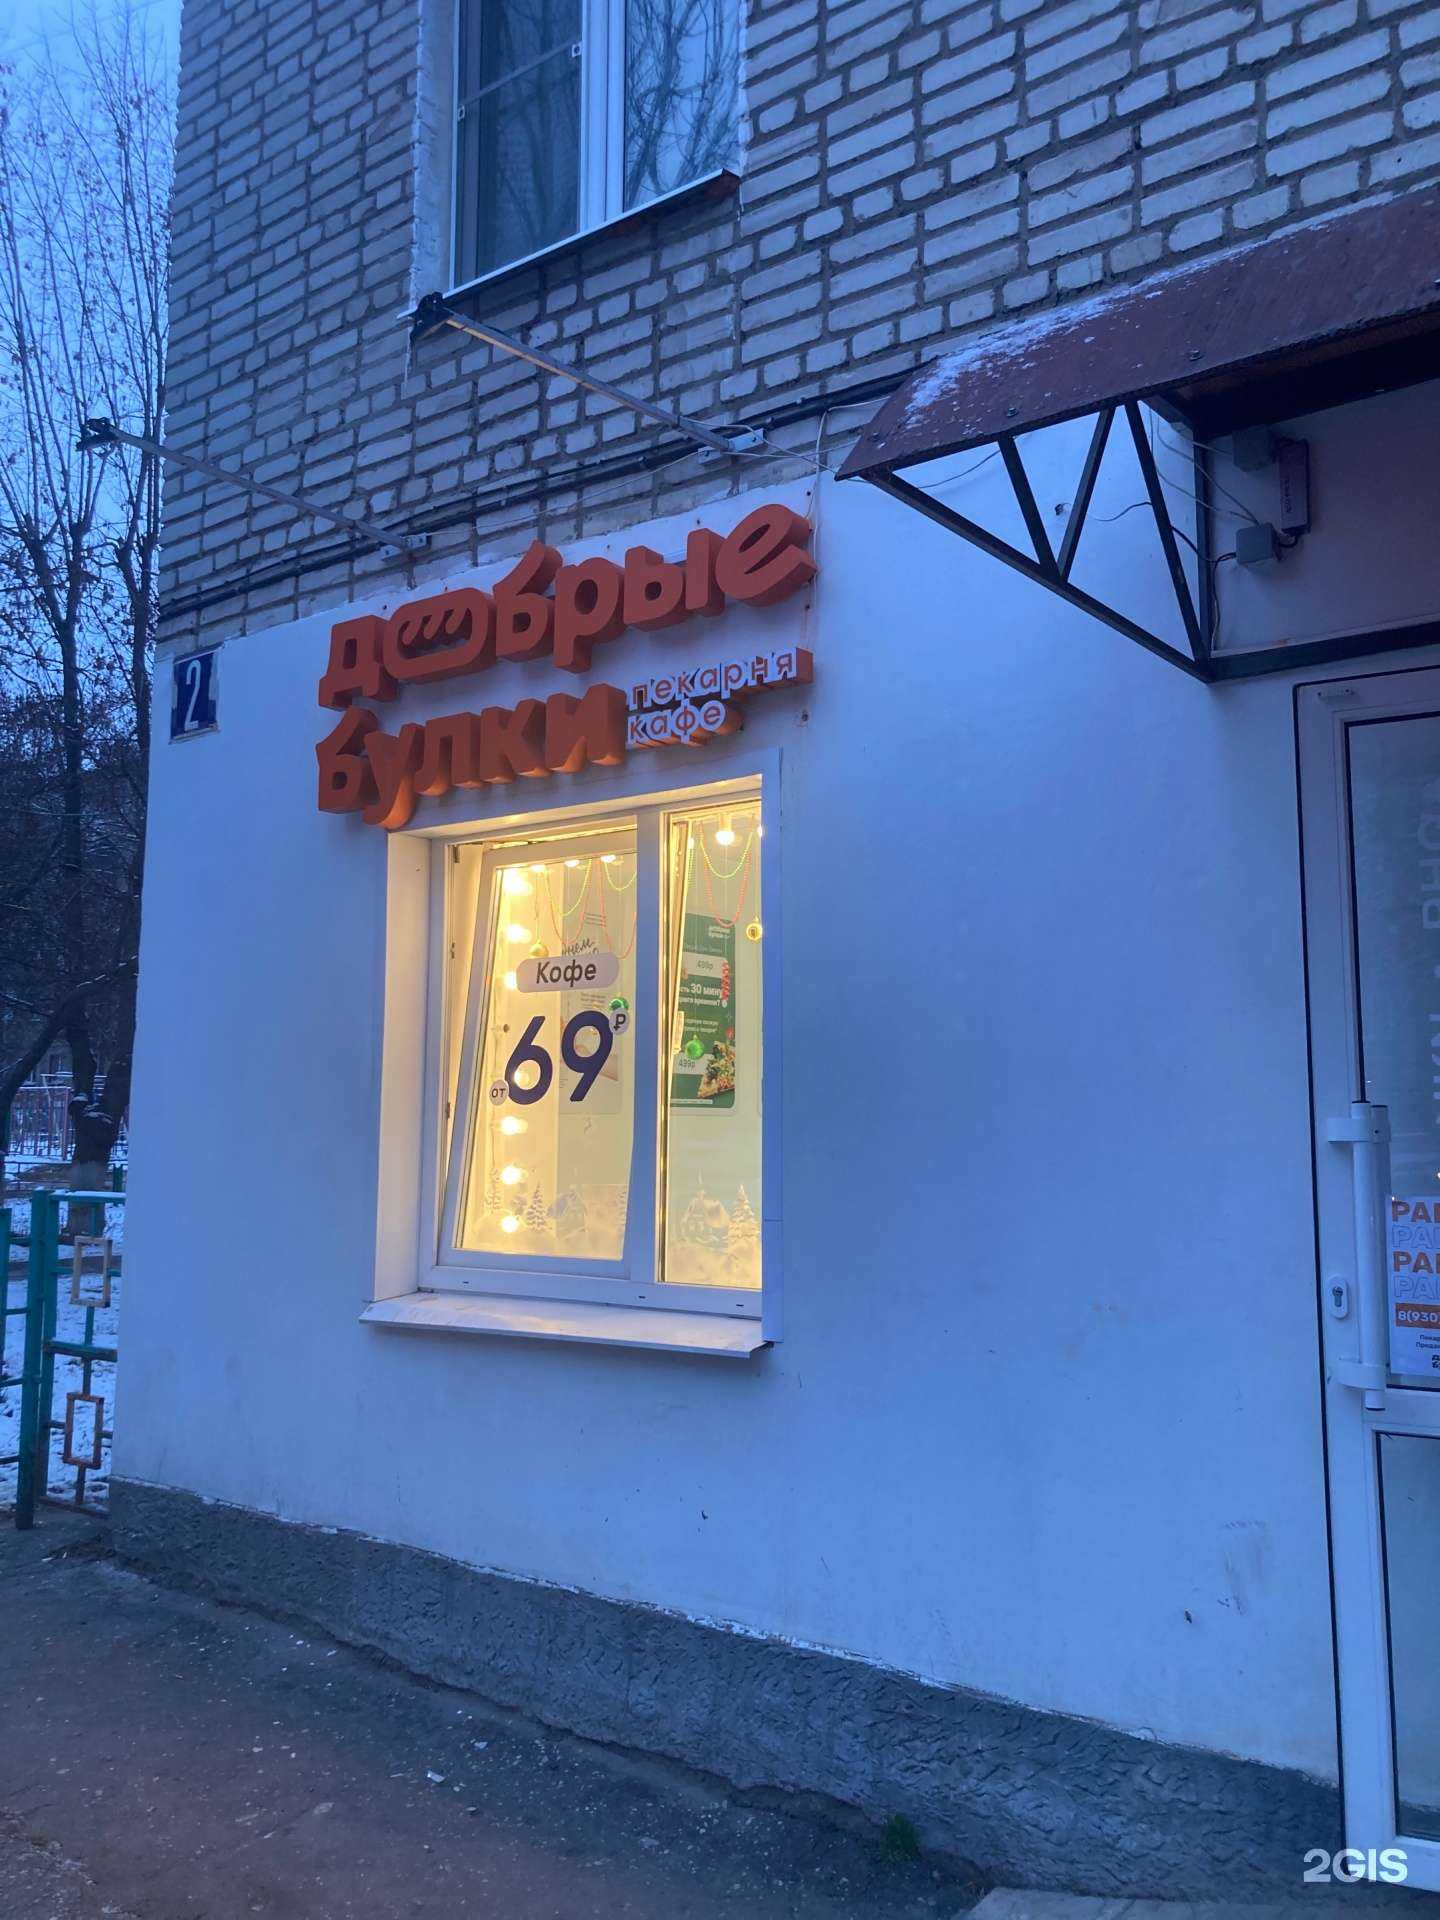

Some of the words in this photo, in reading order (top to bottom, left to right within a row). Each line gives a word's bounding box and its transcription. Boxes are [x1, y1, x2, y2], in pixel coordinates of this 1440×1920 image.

[319, 504, 816, 708] добрые
[185, 657, 201, 732] 2
[630, 649, 798, 707] пекарня
[316, 684, 625, 827] булки
[628, 699, 727, 745] кафе
[535, 959, 597, 988] Кофе
[491, 1086, 506, 1098] от
[504, 1010, 614, 1105] 69
